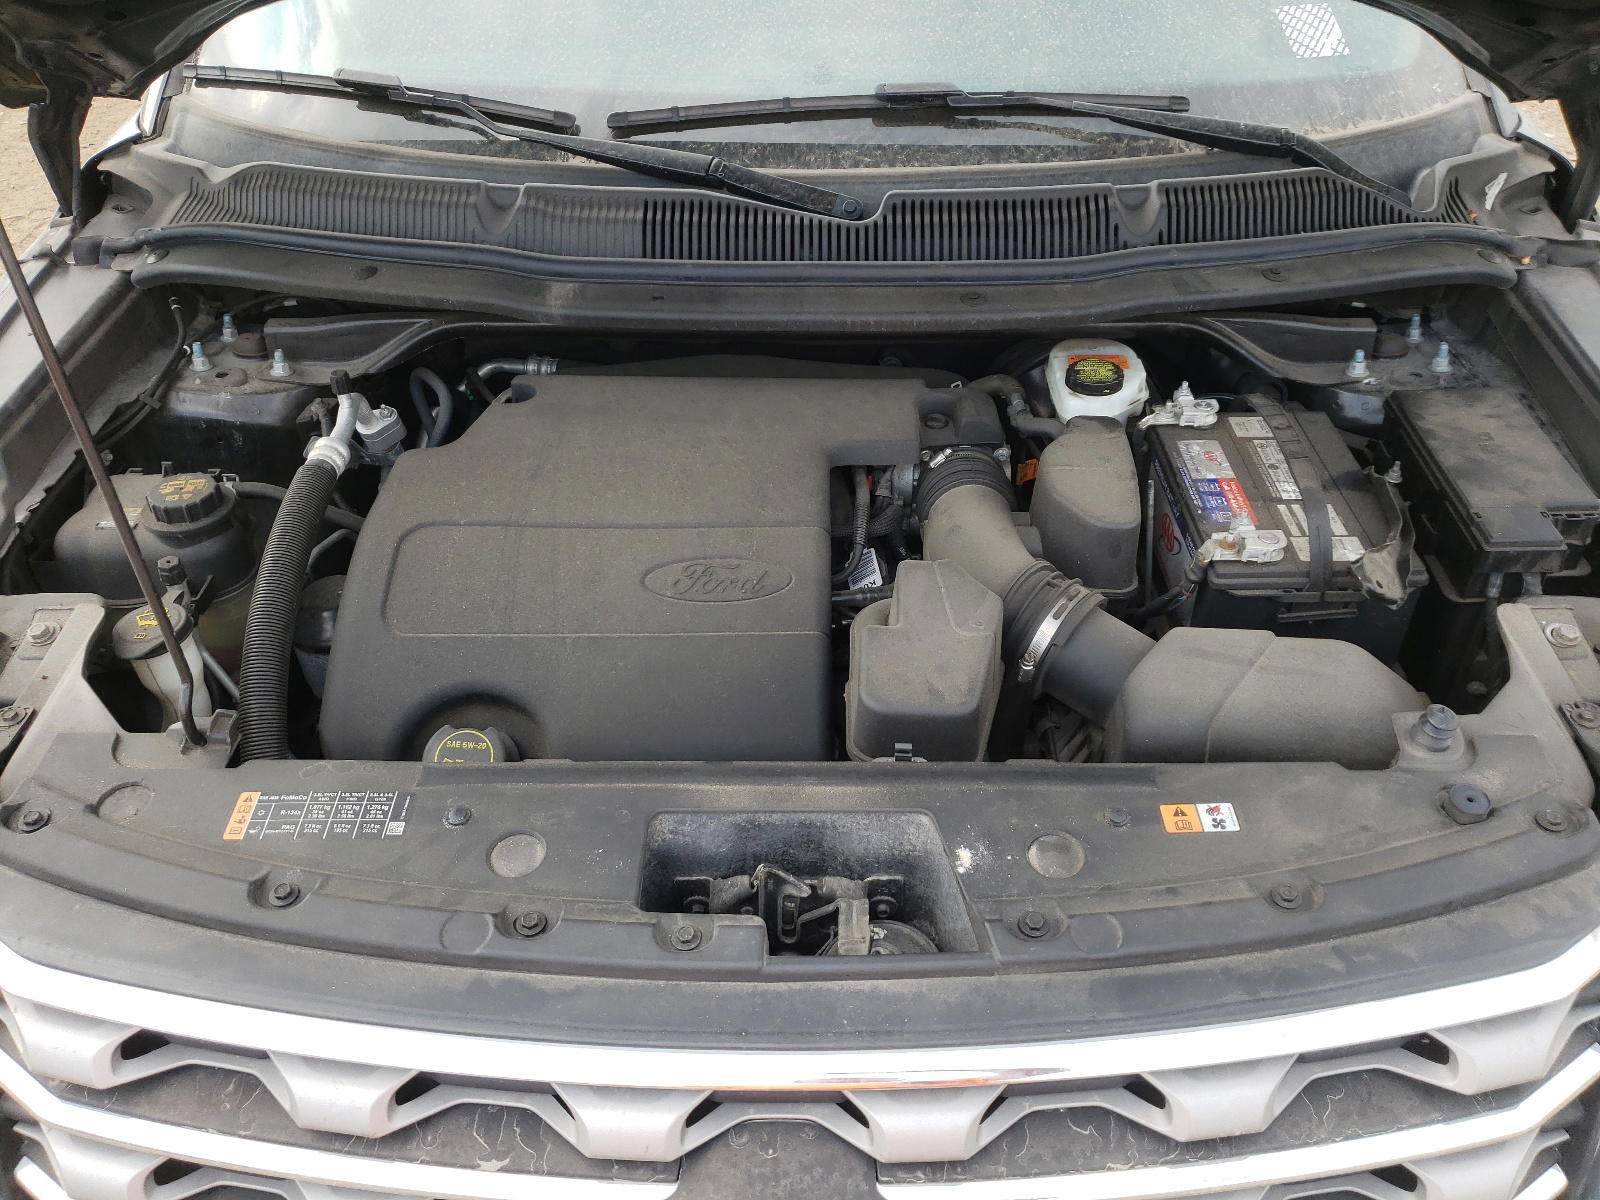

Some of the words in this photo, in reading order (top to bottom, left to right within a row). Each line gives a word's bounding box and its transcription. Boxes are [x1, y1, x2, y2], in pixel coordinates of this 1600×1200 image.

[672, 563, 769, 595] Ford
[446, 740, 461, 748] SAE
[462, 740, 487, 750] 5W-20
